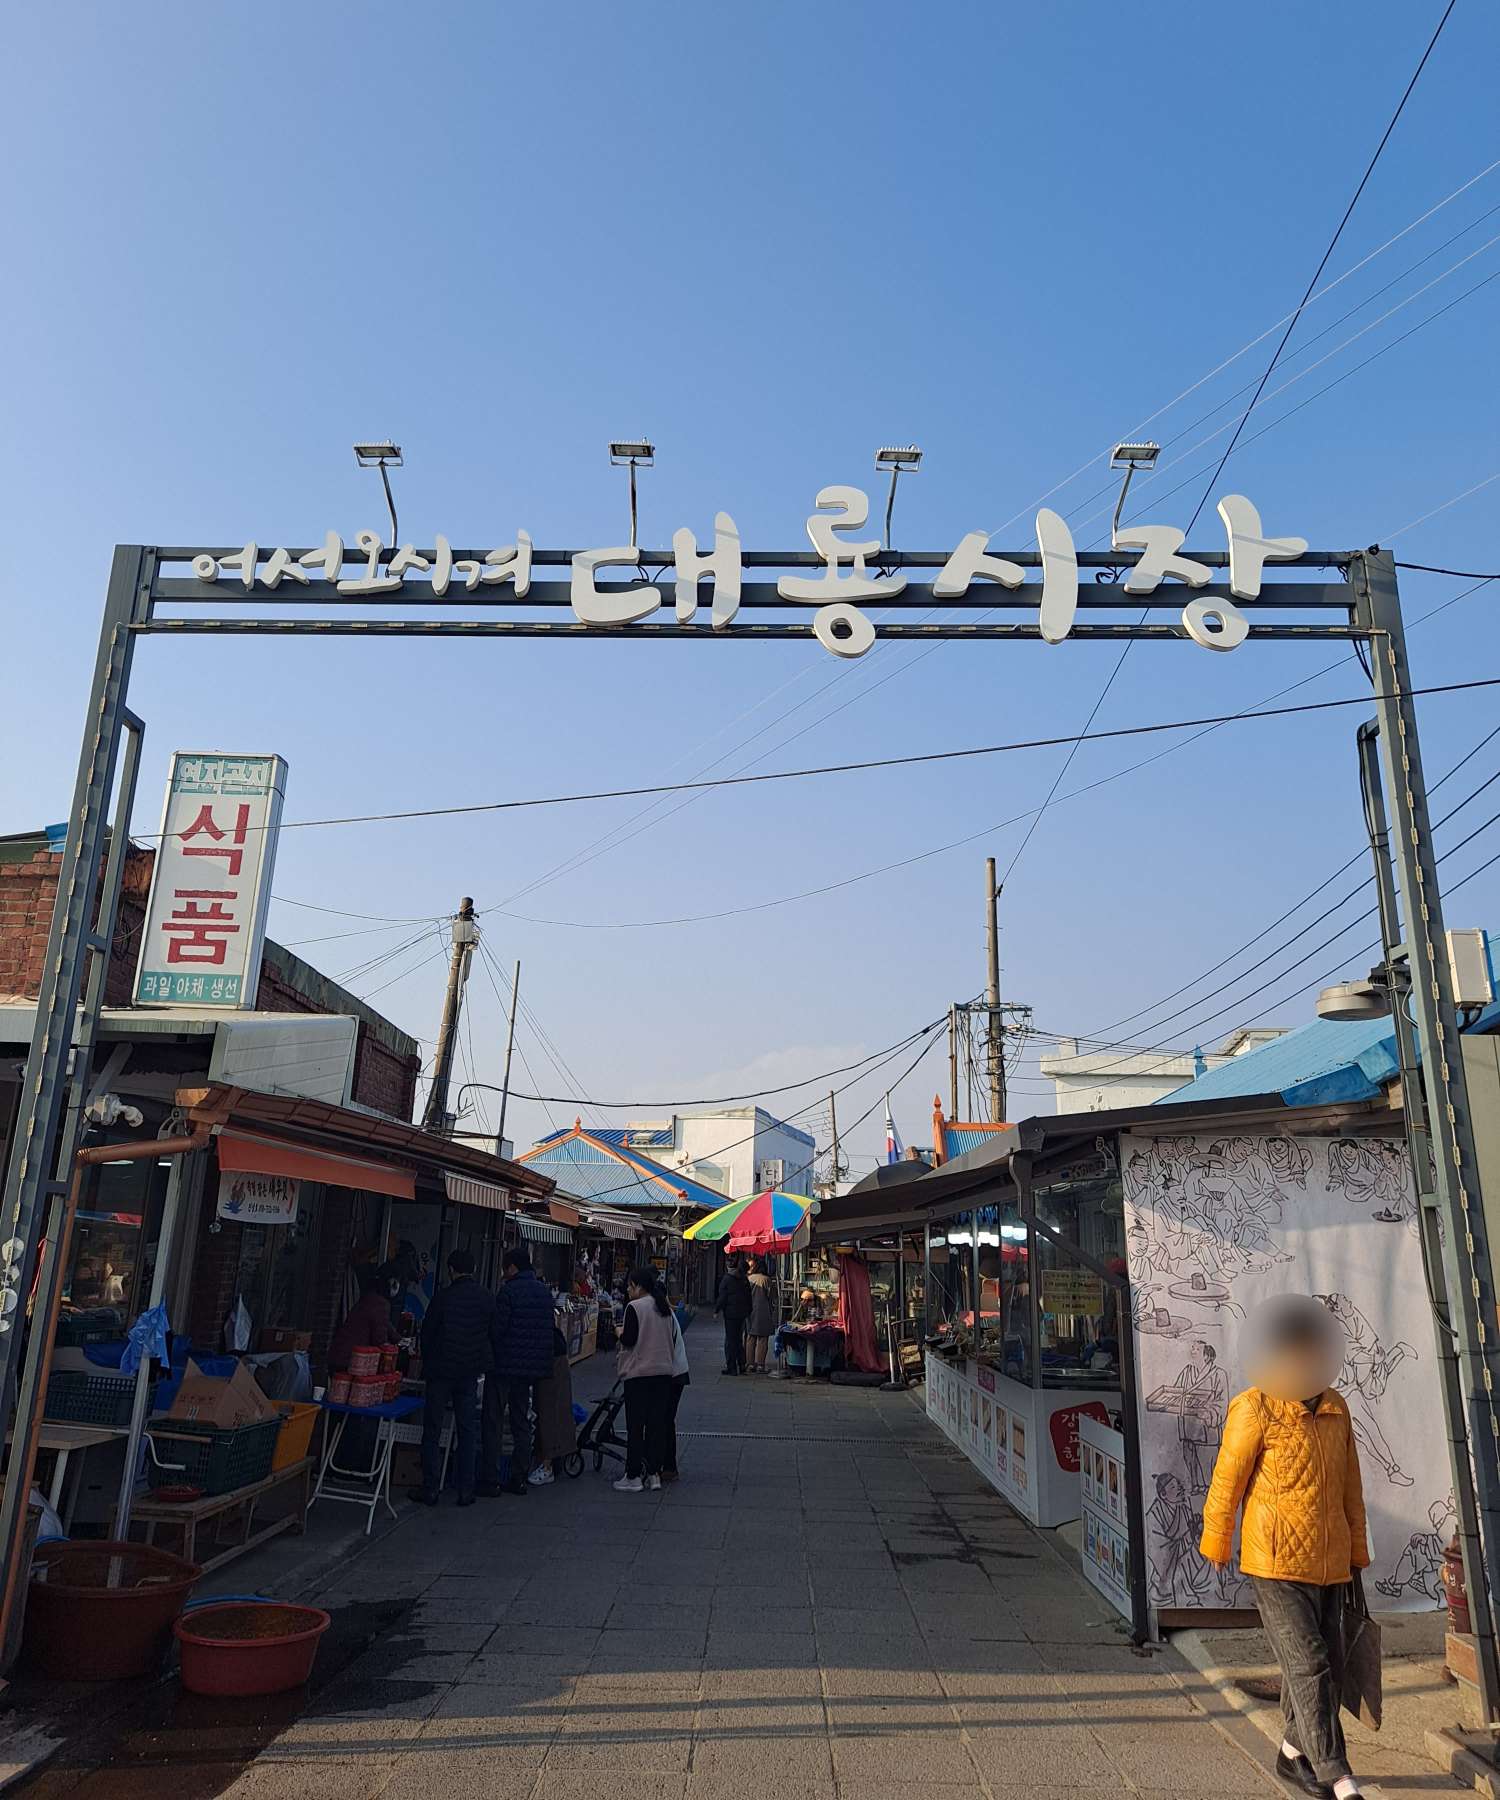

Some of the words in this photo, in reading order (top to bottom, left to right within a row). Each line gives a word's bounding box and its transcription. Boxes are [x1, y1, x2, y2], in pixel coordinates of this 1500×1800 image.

[191, 529, 533, 598] 어서오시겨
[571, 485, 1309, 659] 대룡시장
[161, 803, 251, 965] 식품
